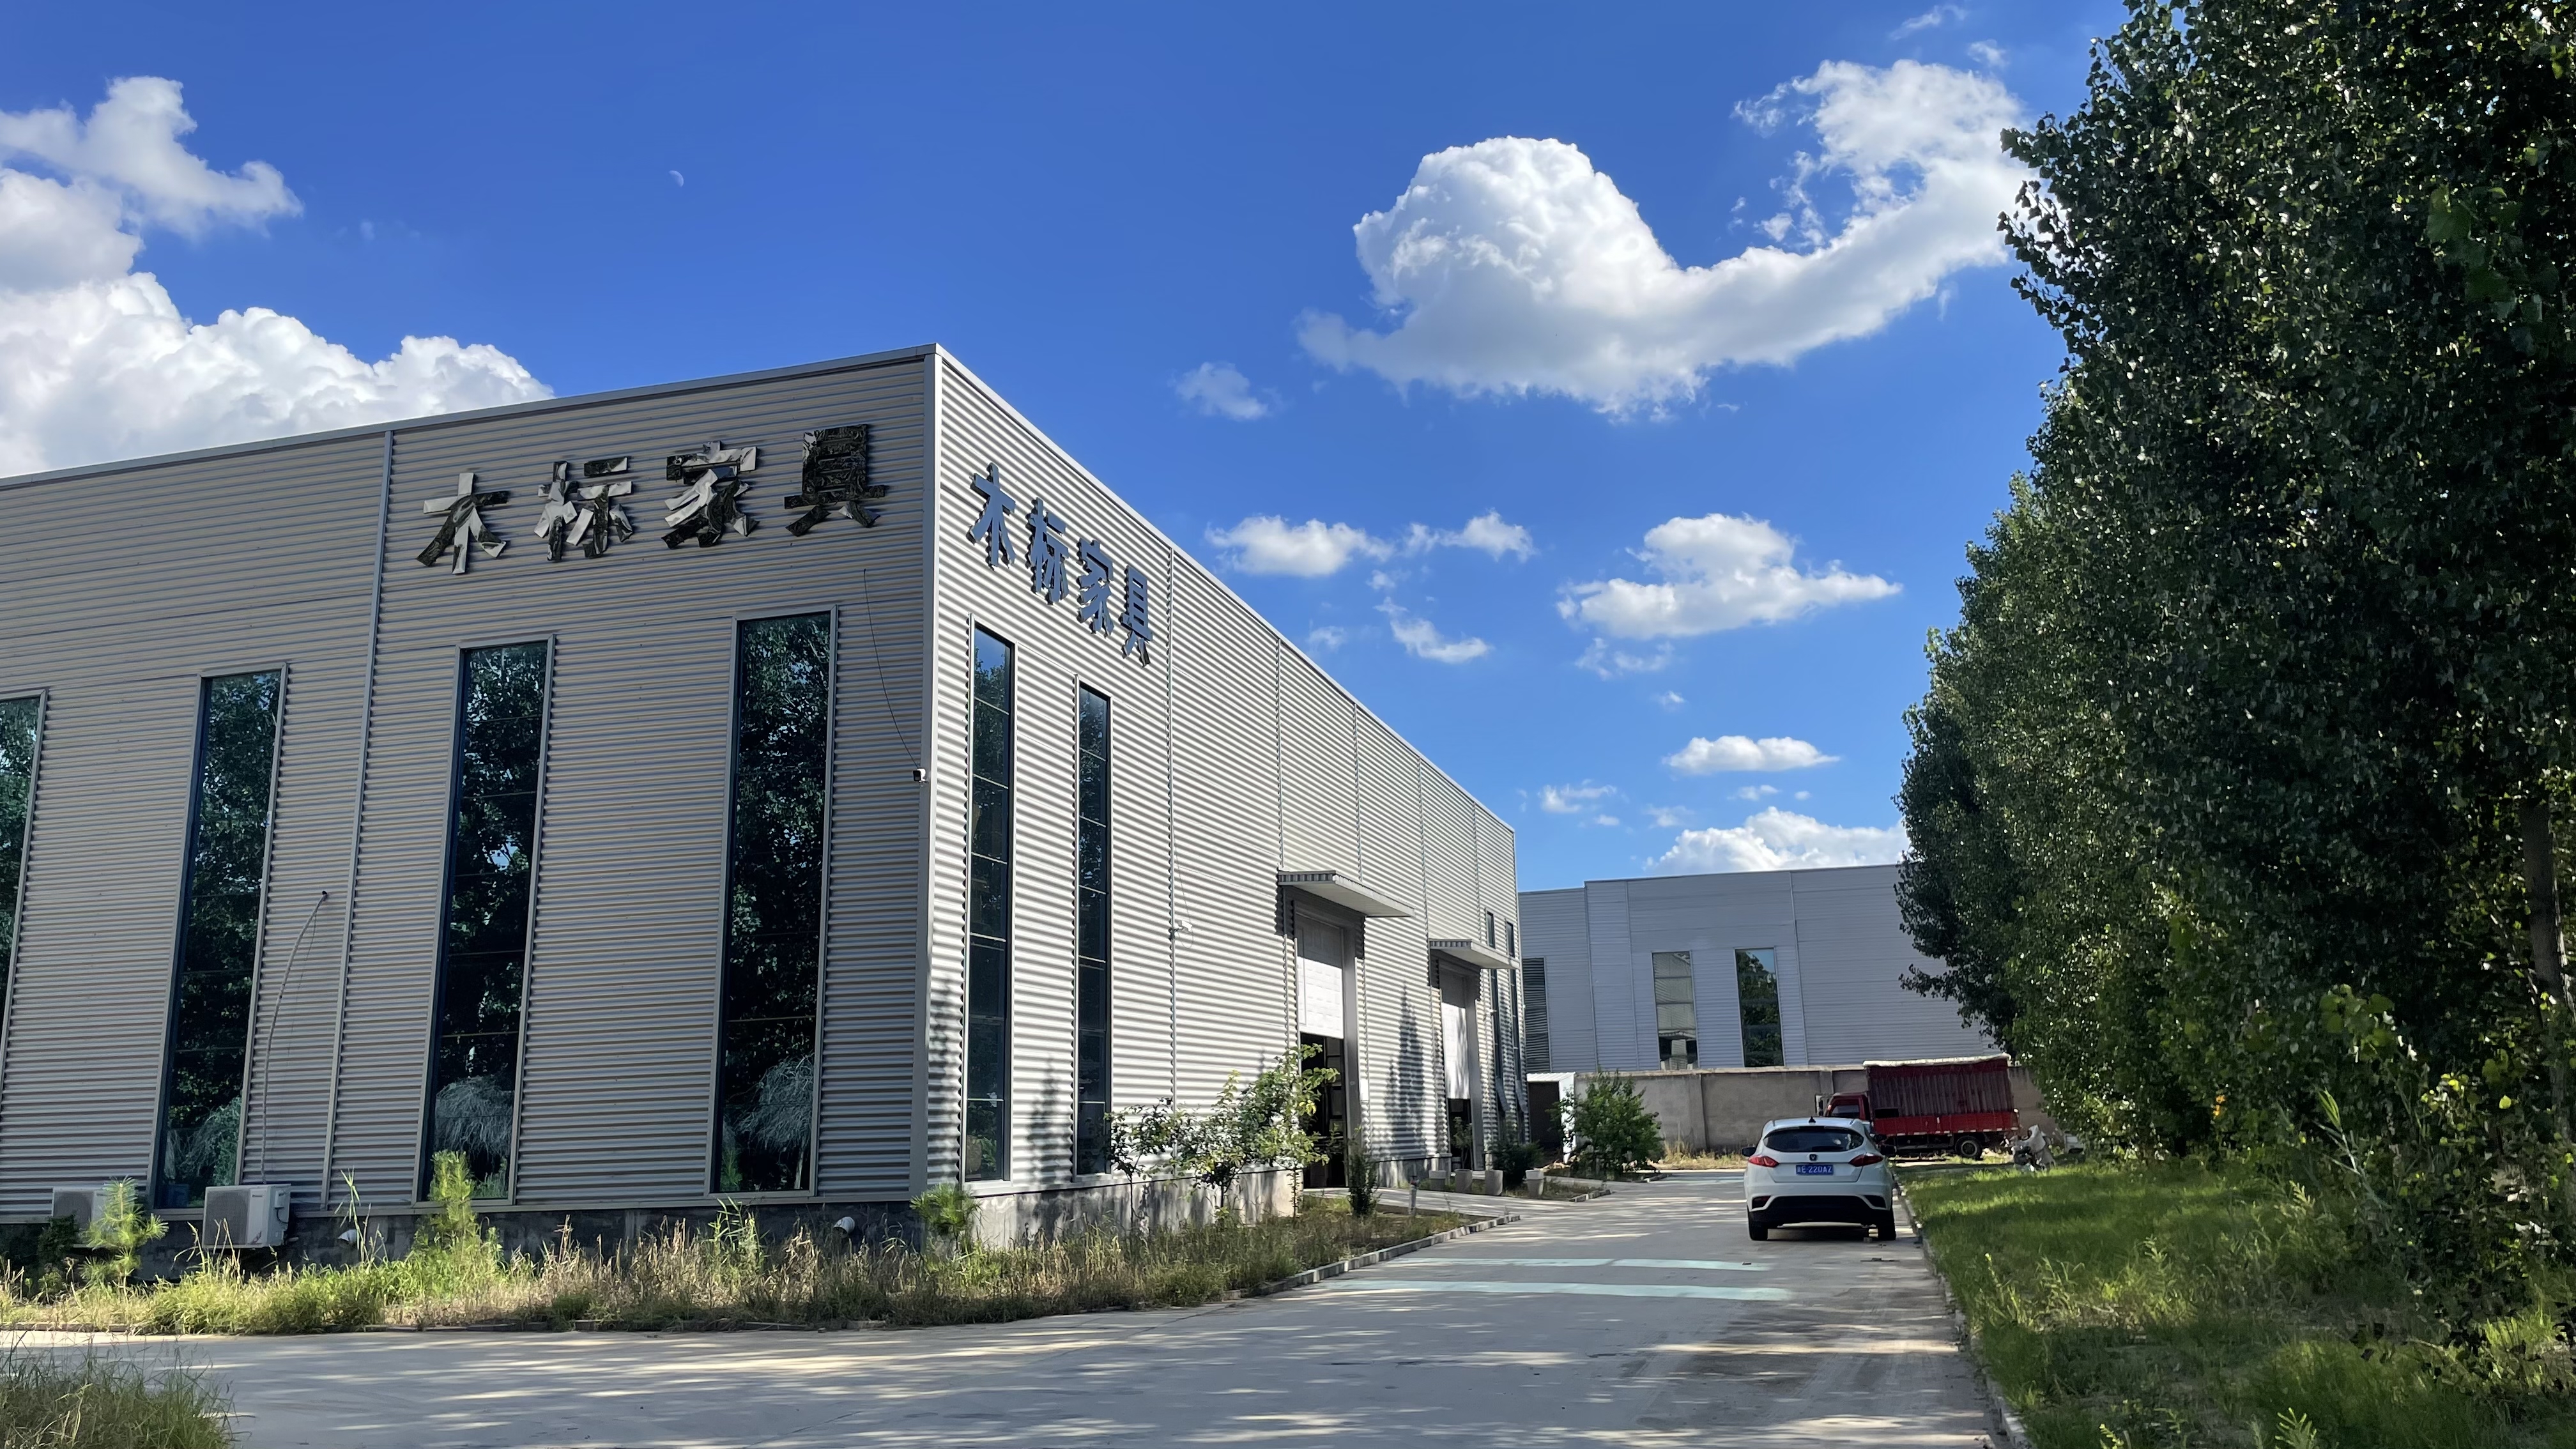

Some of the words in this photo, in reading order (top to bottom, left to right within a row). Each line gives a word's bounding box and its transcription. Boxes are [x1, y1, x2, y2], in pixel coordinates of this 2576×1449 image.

[416, 424, 885, 574] 木标家具
[967, 462, 1153, 668] 木标家具
